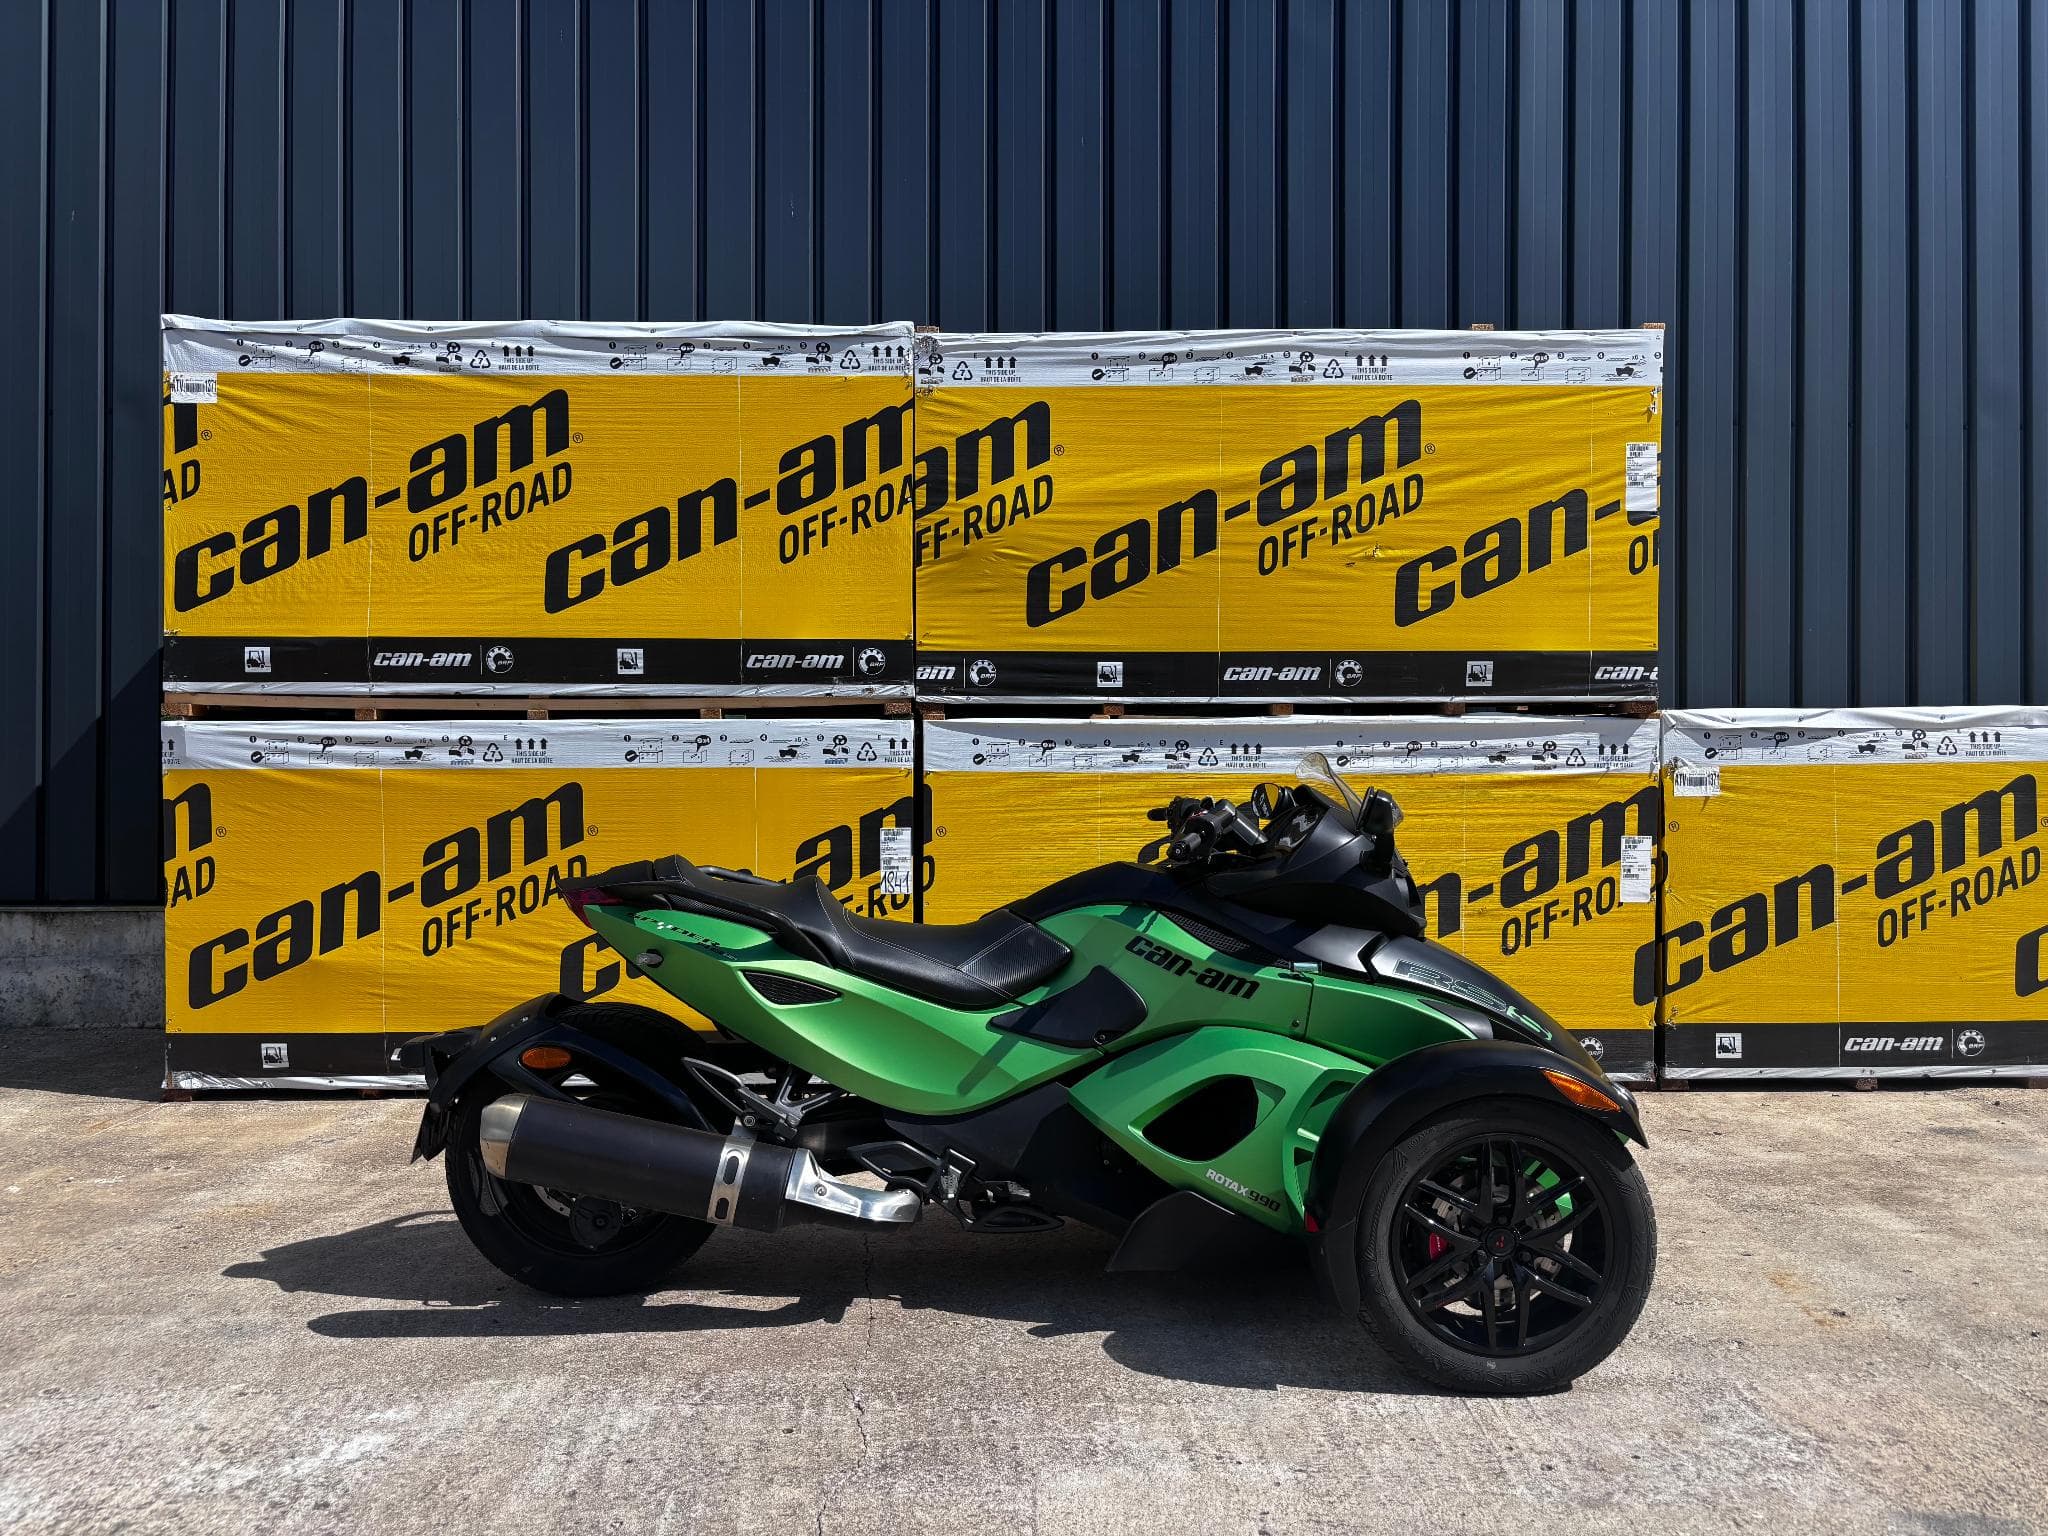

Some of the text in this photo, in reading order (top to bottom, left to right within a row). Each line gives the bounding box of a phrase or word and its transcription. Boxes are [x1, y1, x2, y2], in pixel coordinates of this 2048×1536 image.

[175, 389, 570, 612] can-am
[409, 461, 573, 563] OFF-ROAD
[545, 402, 912, 614] can-am
[1027, 399, 1421, 628] can-am
[1258, 473, 1424, 577] OFF-ROAD
[1395, 488, 1659, 627] can-
[374, 652, 473, 667] can-am
[746, 654, 844, 669] can-am
[1223, 667, 1322, 681] can-am
[189, 782, 584, 1010] can-am
[1633, 774, 2037, 1006] can-am
[1878, 845, 2042, 948] OFF-ROAD
[1125, 935, 1260, 999] can-am
[1844, 1036, 1943, 1051] can-am
[1205, 1168, 1281, 1212] ROTAX 990
